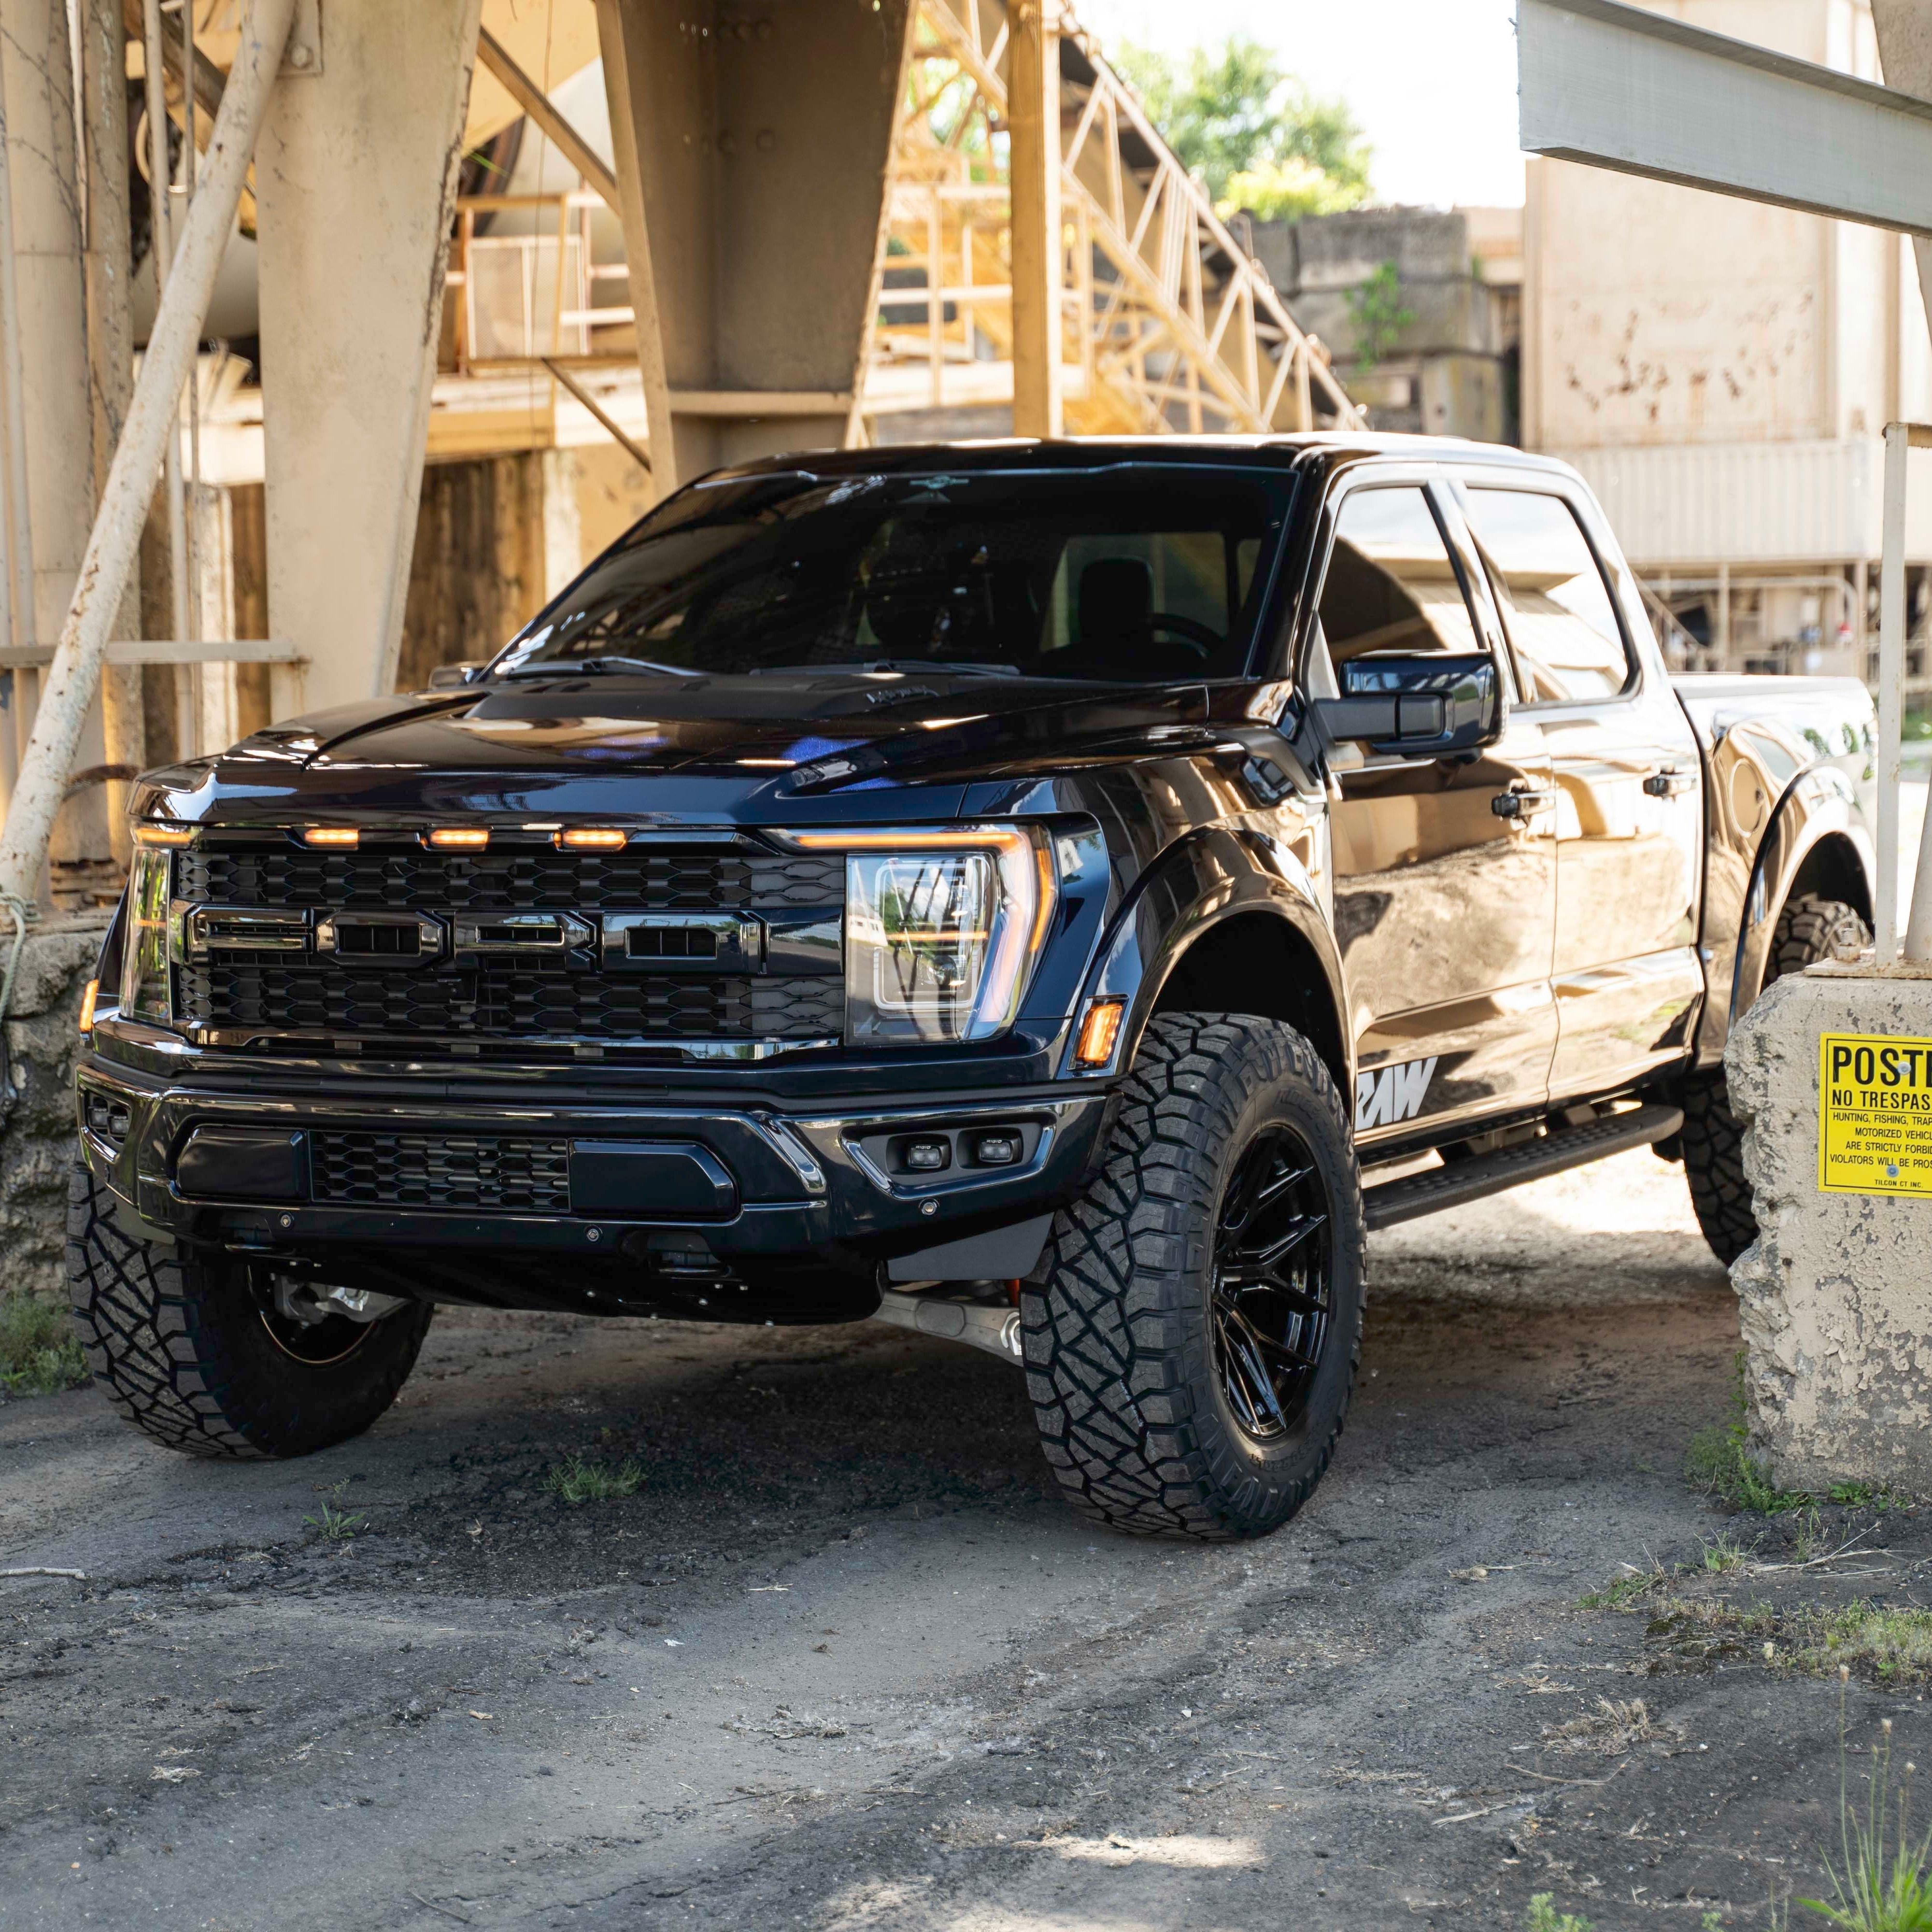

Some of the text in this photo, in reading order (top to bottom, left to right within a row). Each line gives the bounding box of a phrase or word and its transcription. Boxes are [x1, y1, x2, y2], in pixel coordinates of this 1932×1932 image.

[186, 904, 766, 974] FORD
[1832, 1089, 1931, 1110] NO TRESPAS
[1833, 1112, 1871, 1124] HUNTING,
[1874, 1114, 1909, 1126] FISHING,
[1855, 1127, 1902, 1138] MOTORIZED
[1846, 1141, 1861, 1150] ARE
[1865, 1142, 1902, 1152] STRICTLY
[1830, 1154, 1874, 1165] VIOLATORS
[1877, 1157, 1896, 1166] WILL
[1899, 1158, 1909, 1167] BE
